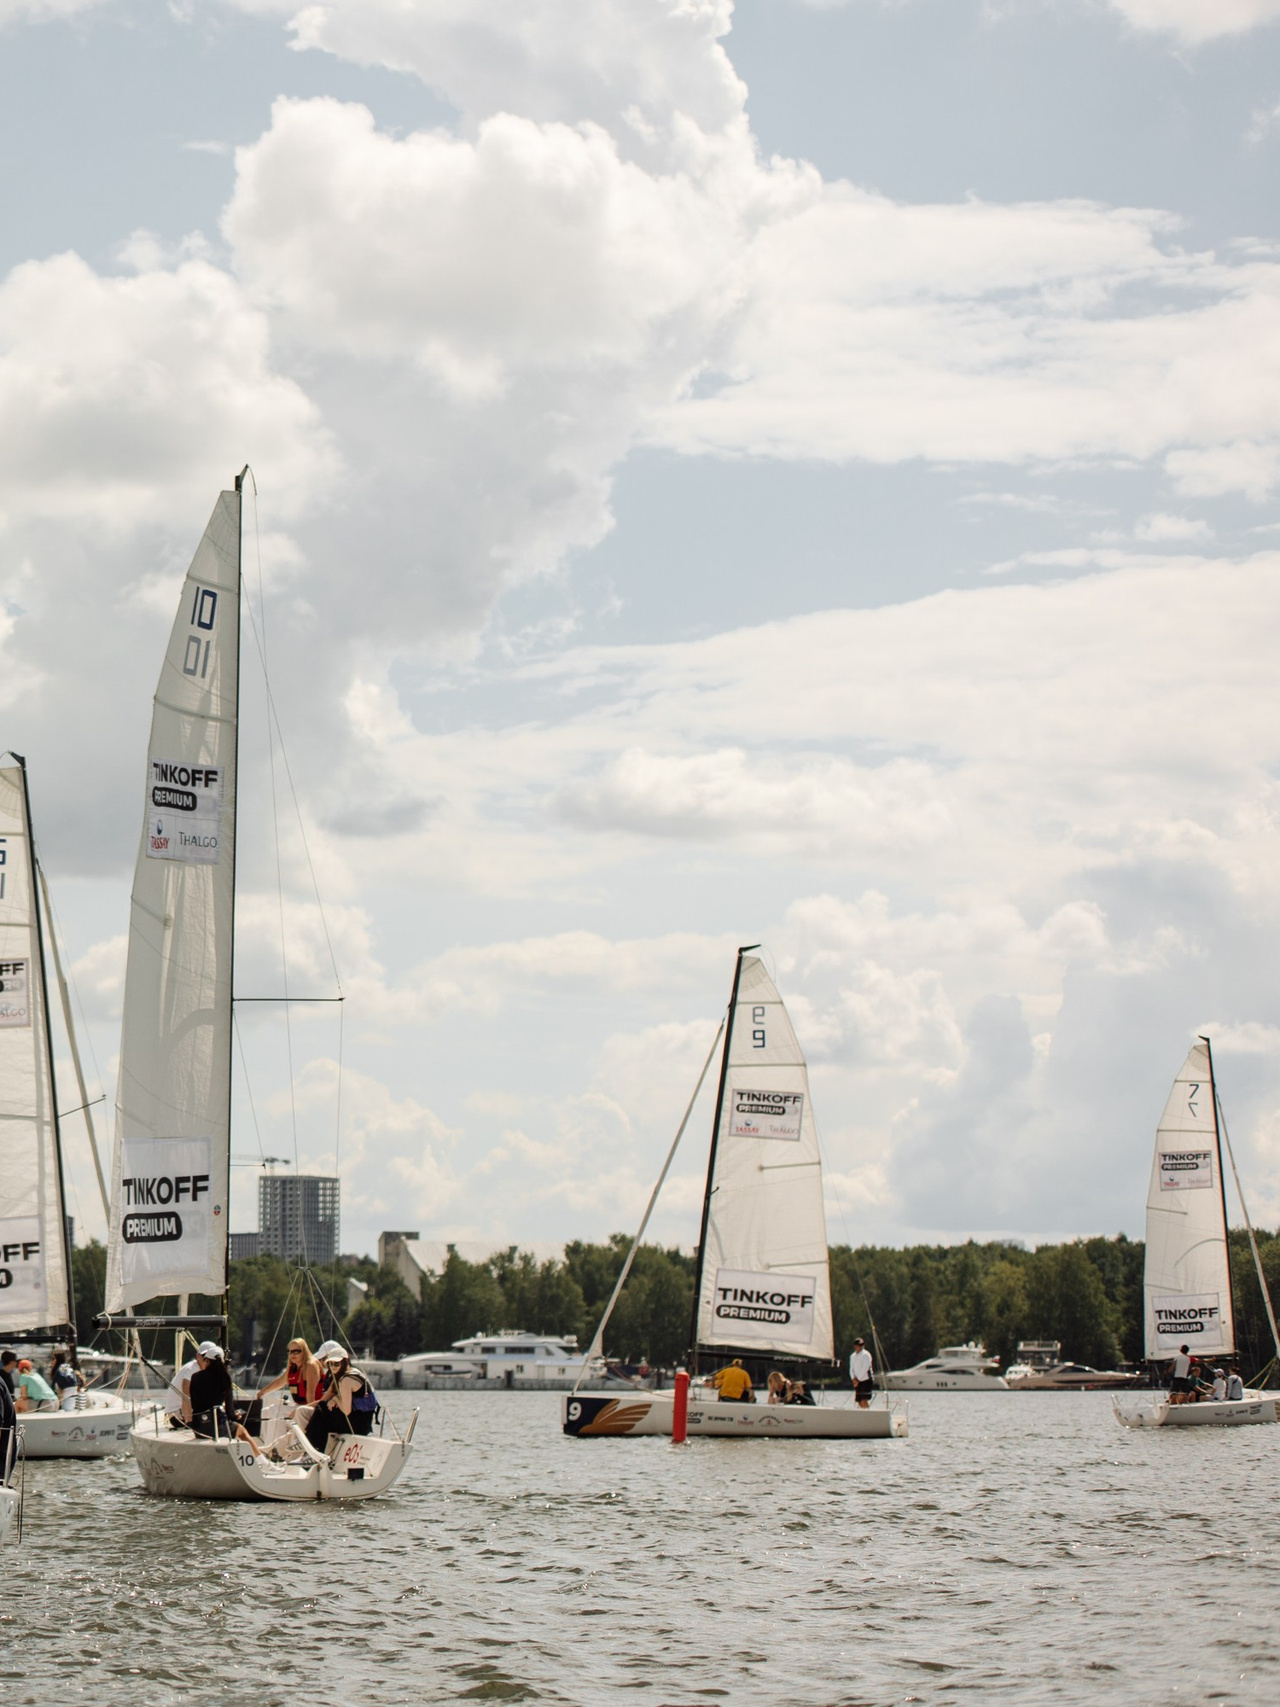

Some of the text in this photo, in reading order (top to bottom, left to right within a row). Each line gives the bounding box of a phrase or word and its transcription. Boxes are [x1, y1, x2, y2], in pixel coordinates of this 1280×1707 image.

[190, 586, 218, 630] 10
[153, 763, 218, 788] TINKOFF
[154, 790, 193, 808] PREMIUM
[178, 831, 218, 848] THALGO
[752, 1029, 766, 1048] 9
[736, 1091, 802, 1105] TINKOFF
[1188, 1083, 1200, 1099] 7
[738, 1104, 784, 1115] PREMIUM
[1161, 1153, 1210, 1162] TINKOFF
[122, 1174, 210, 1207] TINKOFF
[126, 1216, 177, 1238] PREMIUM
[718, 1287, 813, 1308] TINKOFF
[720, 1306, 787, 1323] PREMIUM
[1155, 1307, 1219, 1320] TINKOFF
[1159, 1322, 1202, 1334] PREMIUM
[568, 1402, 582, 1420] 9
[238, 1455, 255, 1467] 10
